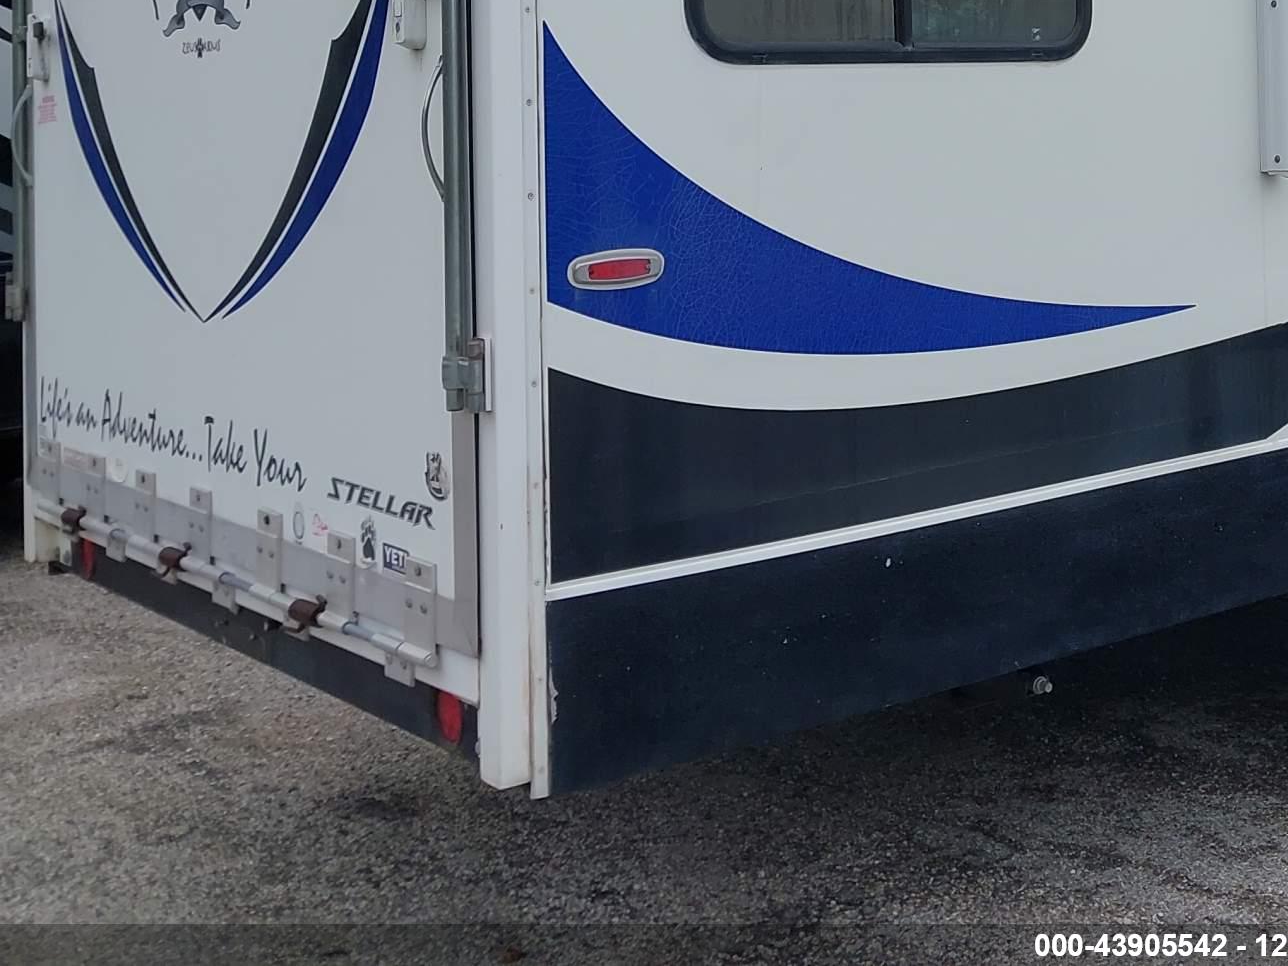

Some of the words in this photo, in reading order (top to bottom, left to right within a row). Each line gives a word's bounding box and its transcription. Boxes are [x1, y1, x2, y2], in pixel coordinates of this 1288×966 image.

[75, 401, 97, 432] an
[253, 428, 308, 493] Your
[326, 477, 436, 531] STELLAR
